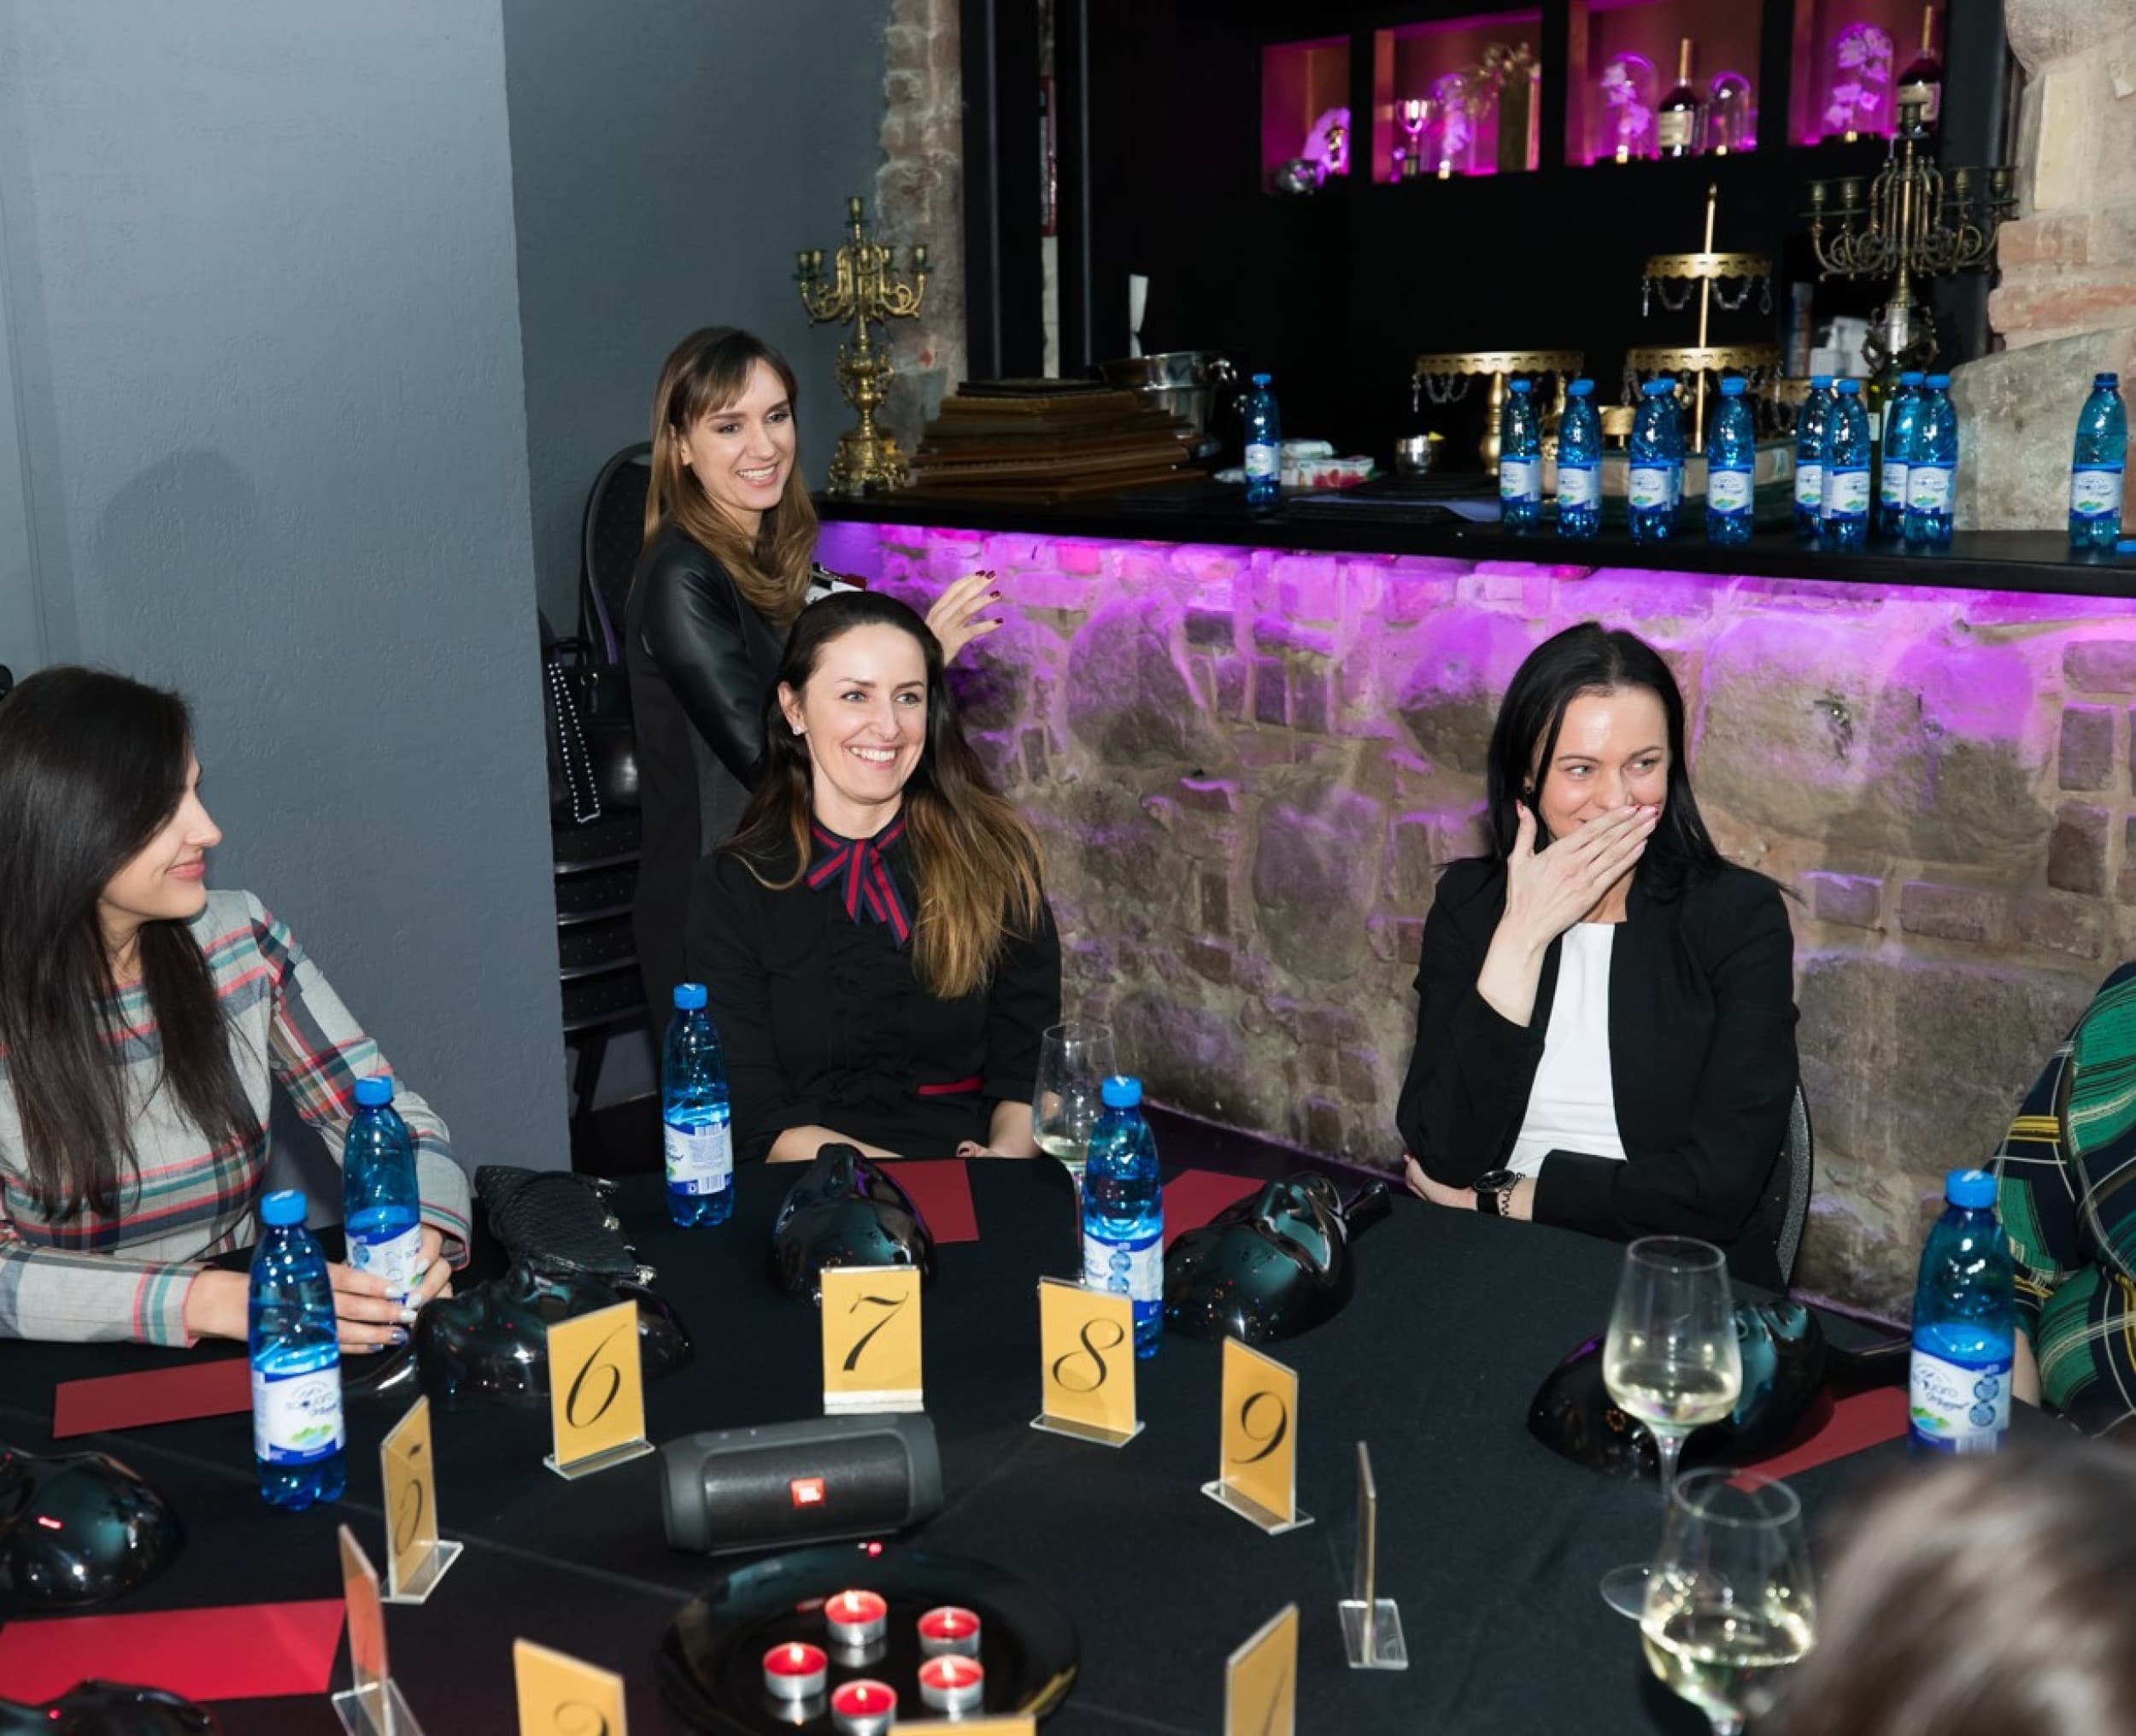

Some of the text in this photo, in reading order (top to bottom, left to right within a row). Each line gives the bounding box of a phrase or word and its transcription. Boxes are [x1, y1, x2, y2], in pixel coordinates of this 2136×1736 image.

[842, 1291, 910, 1373] 7
[1051, 1318, 1126, 1394] 8
[565, 1324, 629, 1430] 6
[1231, 1391, 1289, 1465] 9
[395, 1443, 424, 1557] 5
